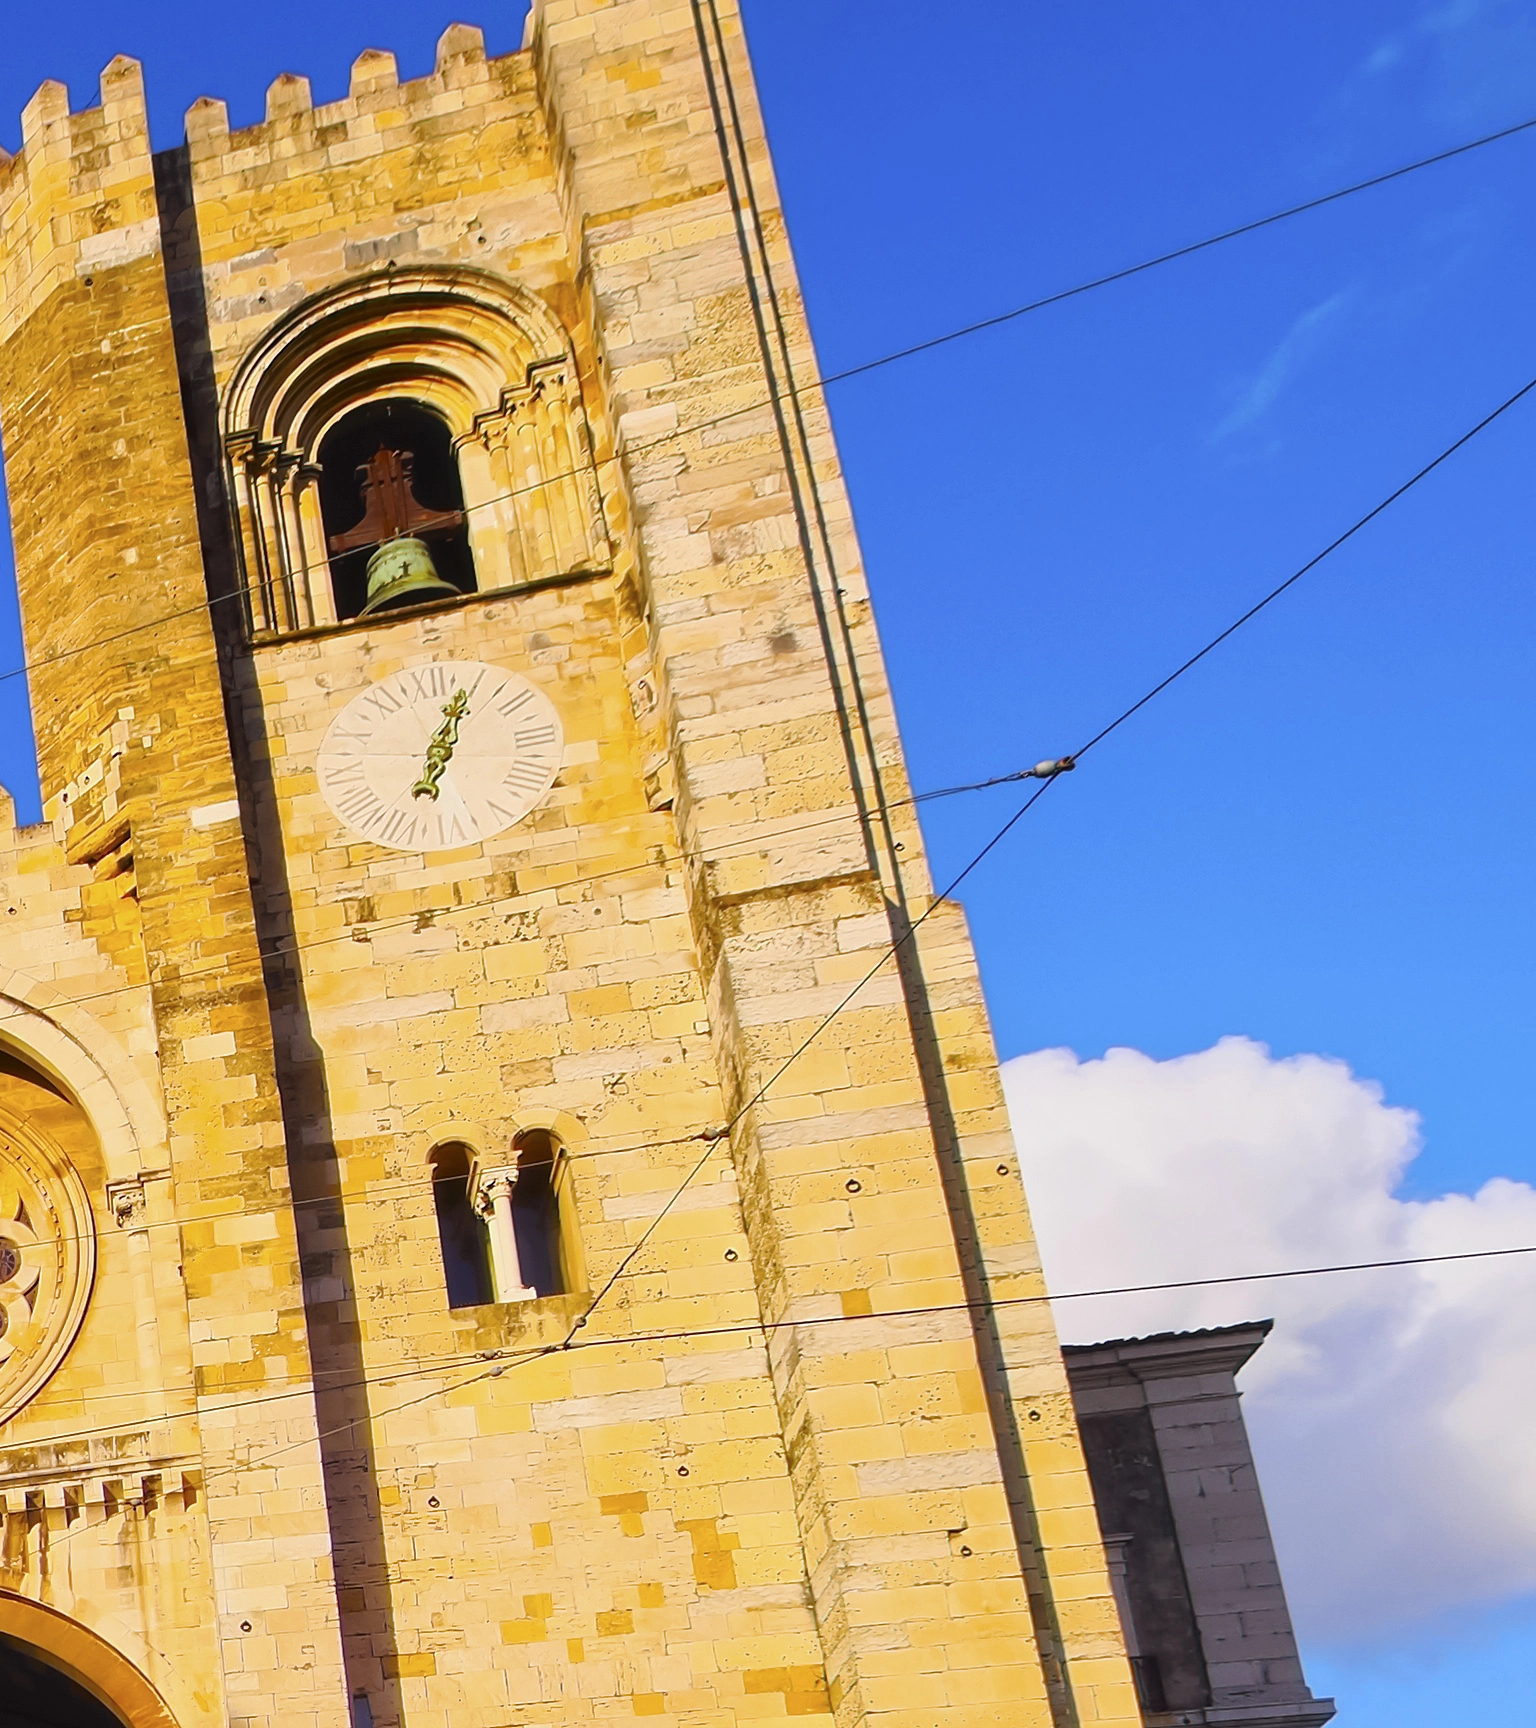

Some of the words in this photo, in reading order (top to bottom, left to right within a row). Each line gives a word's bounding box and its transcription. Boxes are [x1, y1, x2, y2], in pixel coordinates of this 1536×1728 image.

[409, 665, 447, 704] XII
[363, 685, 404, 721] XI
[496, 688, 536, 718] II
[332, 725, 373, 746] X
[514, 723, 556, 749] III
[484, 799, 516, 827] V
